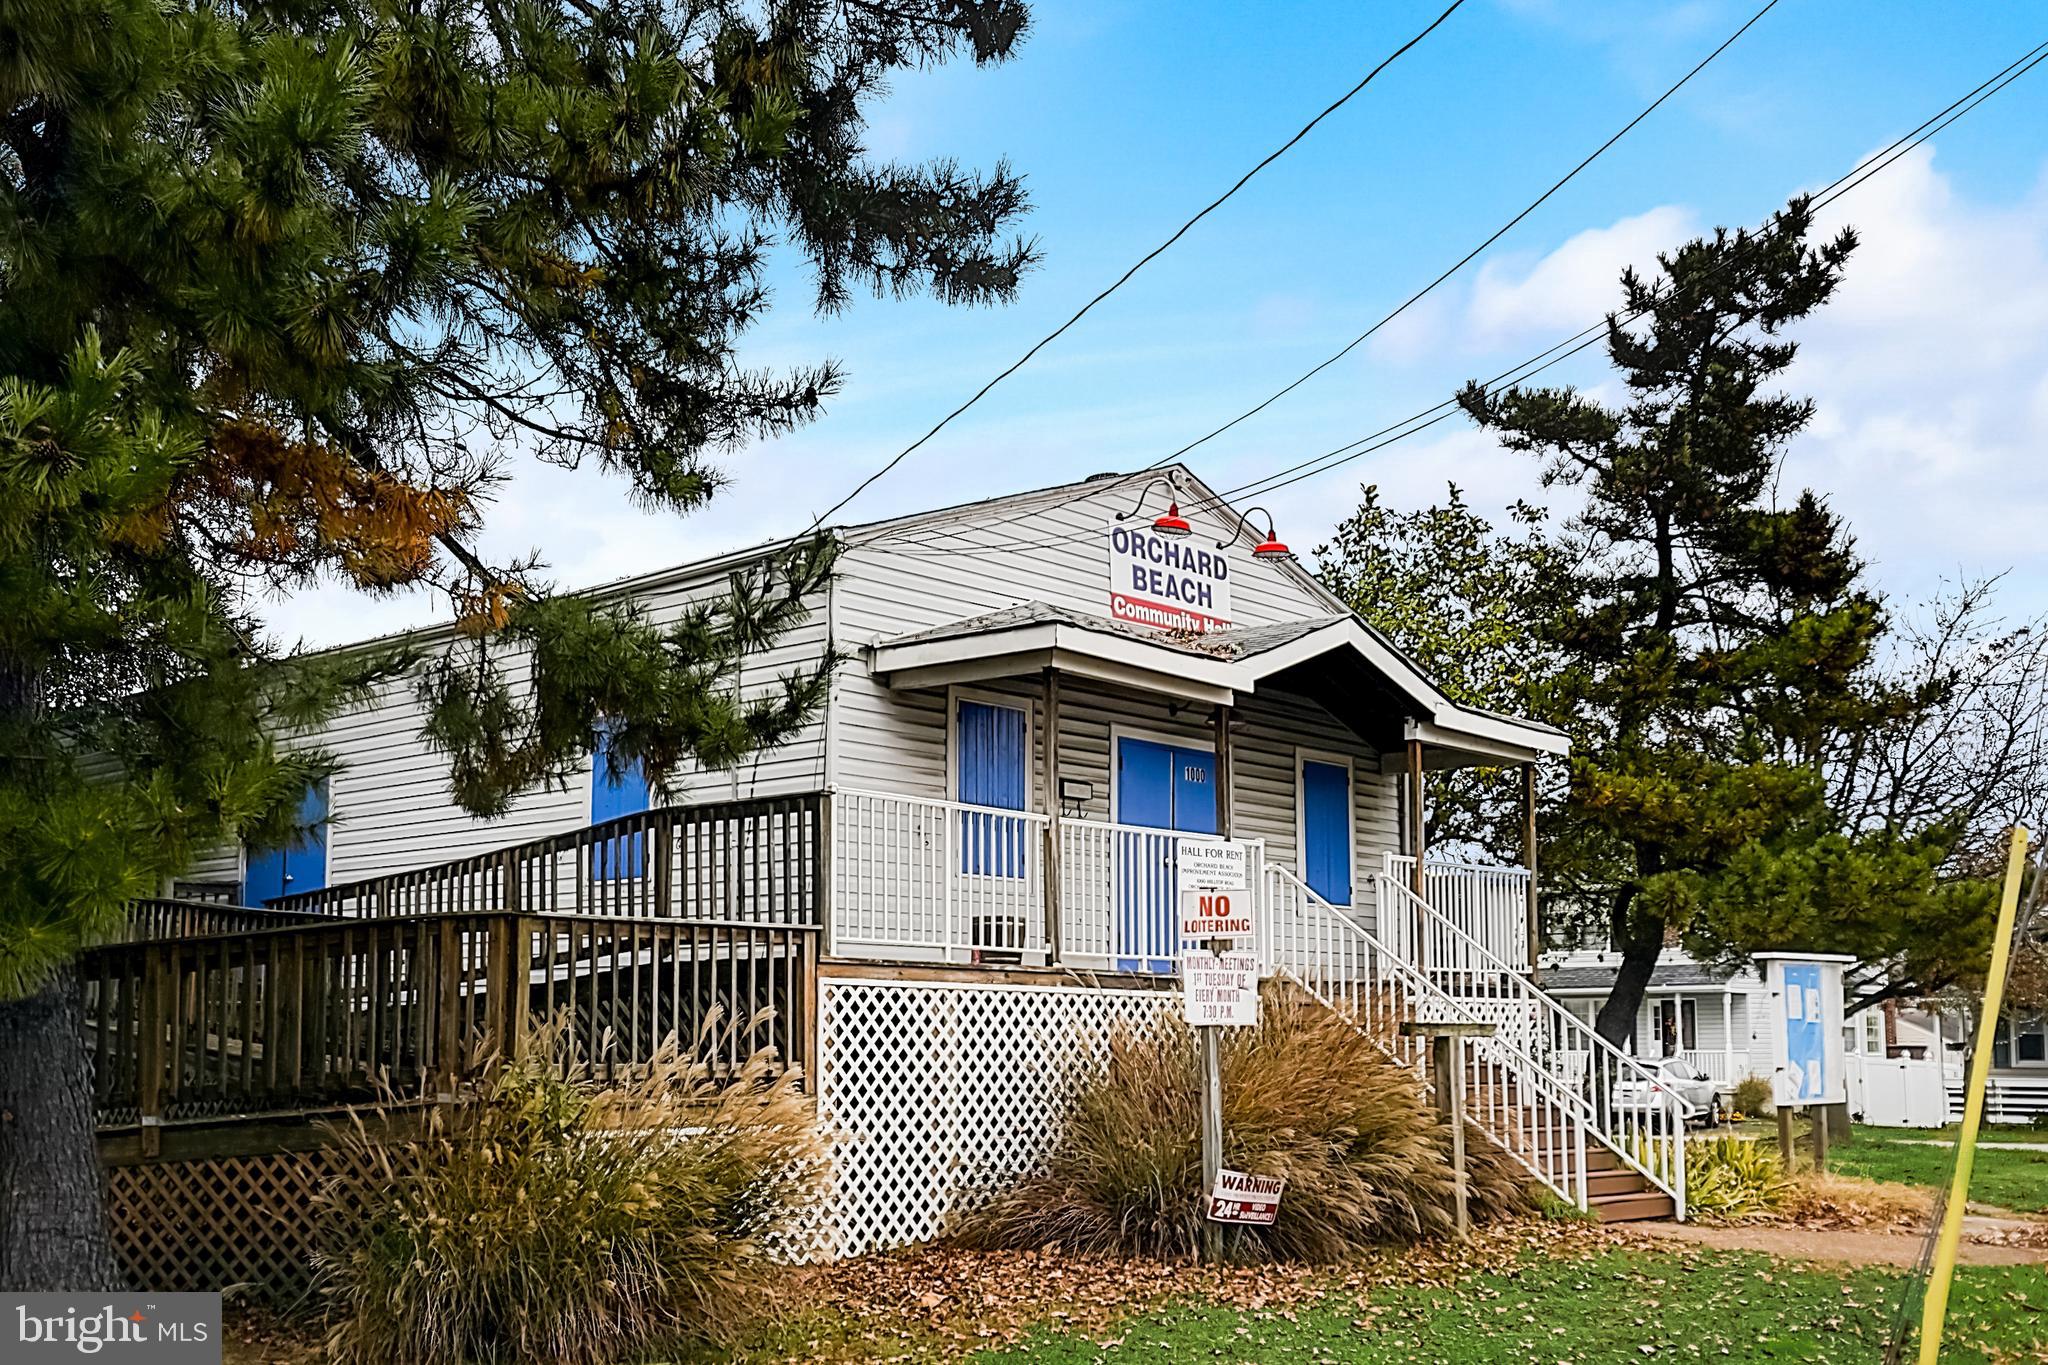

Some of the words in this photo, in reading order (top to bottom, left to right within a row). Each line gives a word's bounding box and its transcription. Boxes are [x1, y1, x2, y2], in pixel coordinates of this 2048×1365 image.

[1112, 527, 1228, 581] ORCHARD
[1132, 564, 1213, 609] BEACH
[1113, 596, 1200, 632] Community
[1185, 766, 1206, 783] 1000
[1181, 846, 1203, 858] HALL
[1205, 848, 1223, 859] FOR
[1226, 850, 1243, 861] RENT
[1199, 895, 1231, 917] NO
[1184, 918, 1251, 934] LOITERING
[1219, 957, 1255, 971] MEETINGS
[1205, 973, 1234, 986] TUESDAY
[1237, 973, 1247, 988] OF
[1216, 989, 1240, 1003] MONTH
[1202, 1005, 1217, 1019] 7:30
[1220, 1005, 1234, 1019] P.M.
[1221, 1174, 1281, 1195] WARNING
[1214, 1200, 1233, 1218] 24
